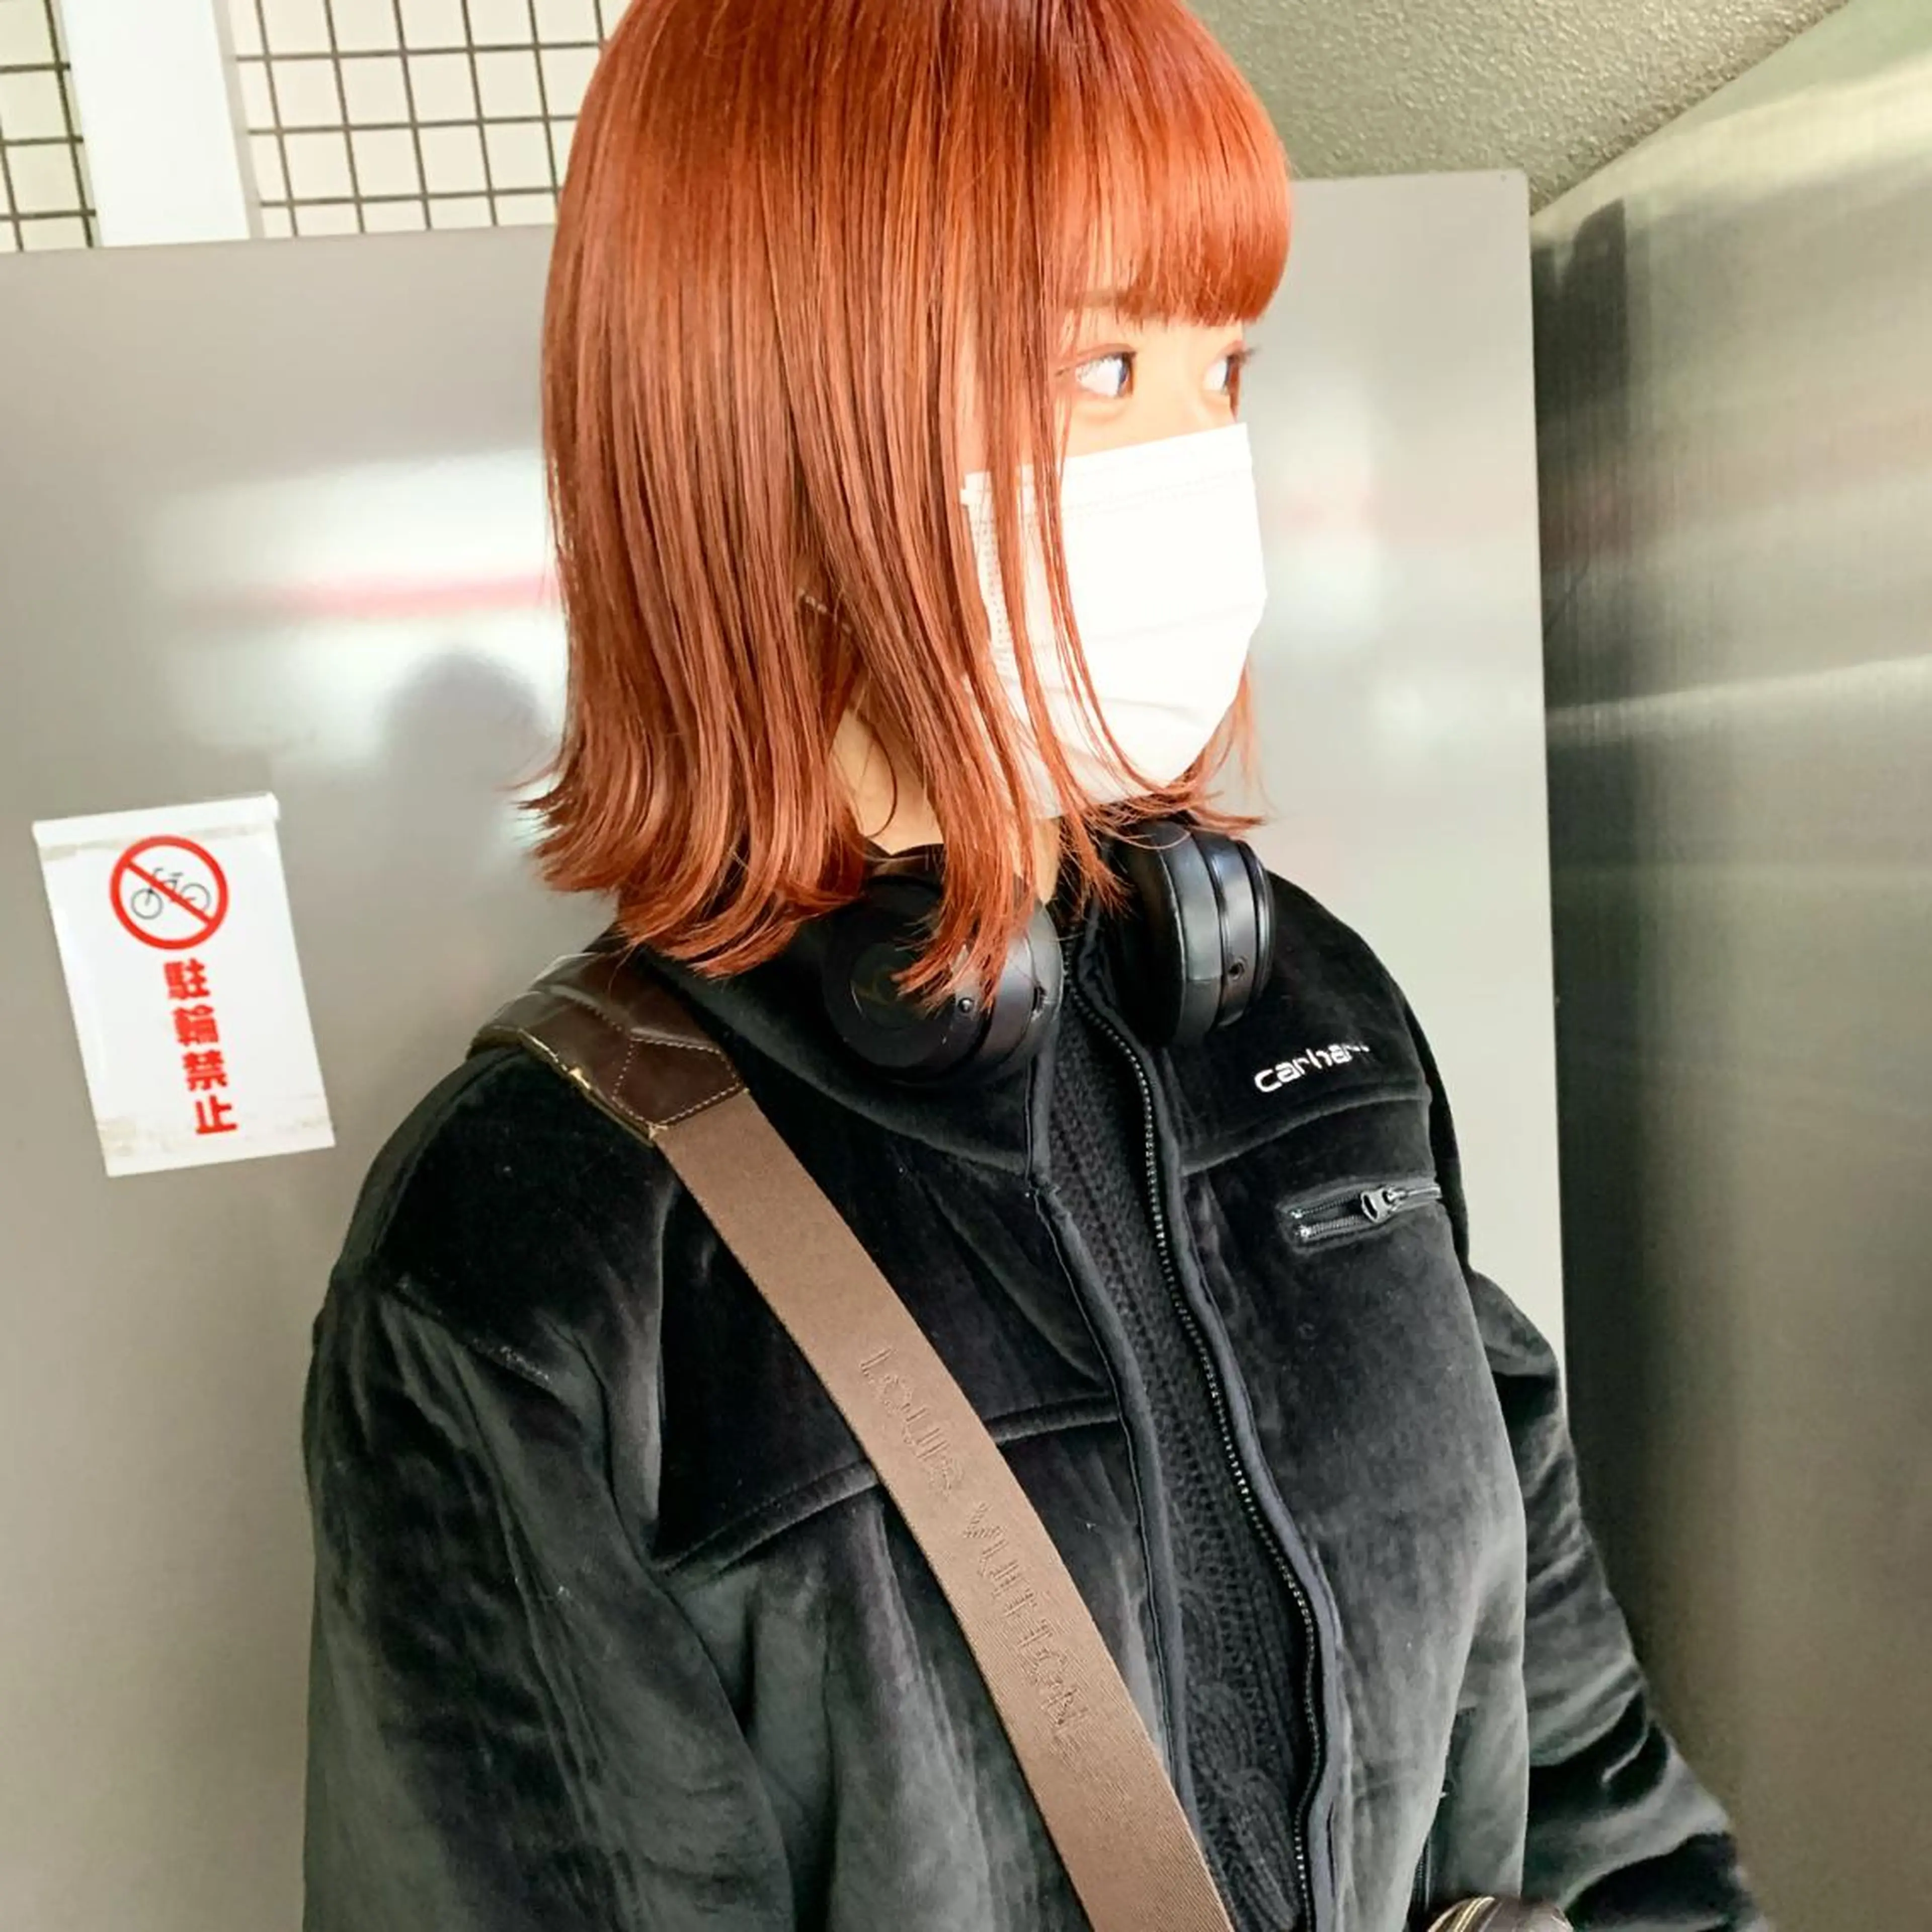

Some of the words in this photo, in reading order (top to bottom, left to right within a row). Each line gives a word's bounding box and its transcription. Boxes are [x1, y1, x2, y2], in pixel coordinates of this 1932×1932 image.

[164, 957, 237, 1134] 駐輪禁止
[859, 1348, 963, 1495] LOUIS
[962, 1502, 1090, 1728] VUITTON
